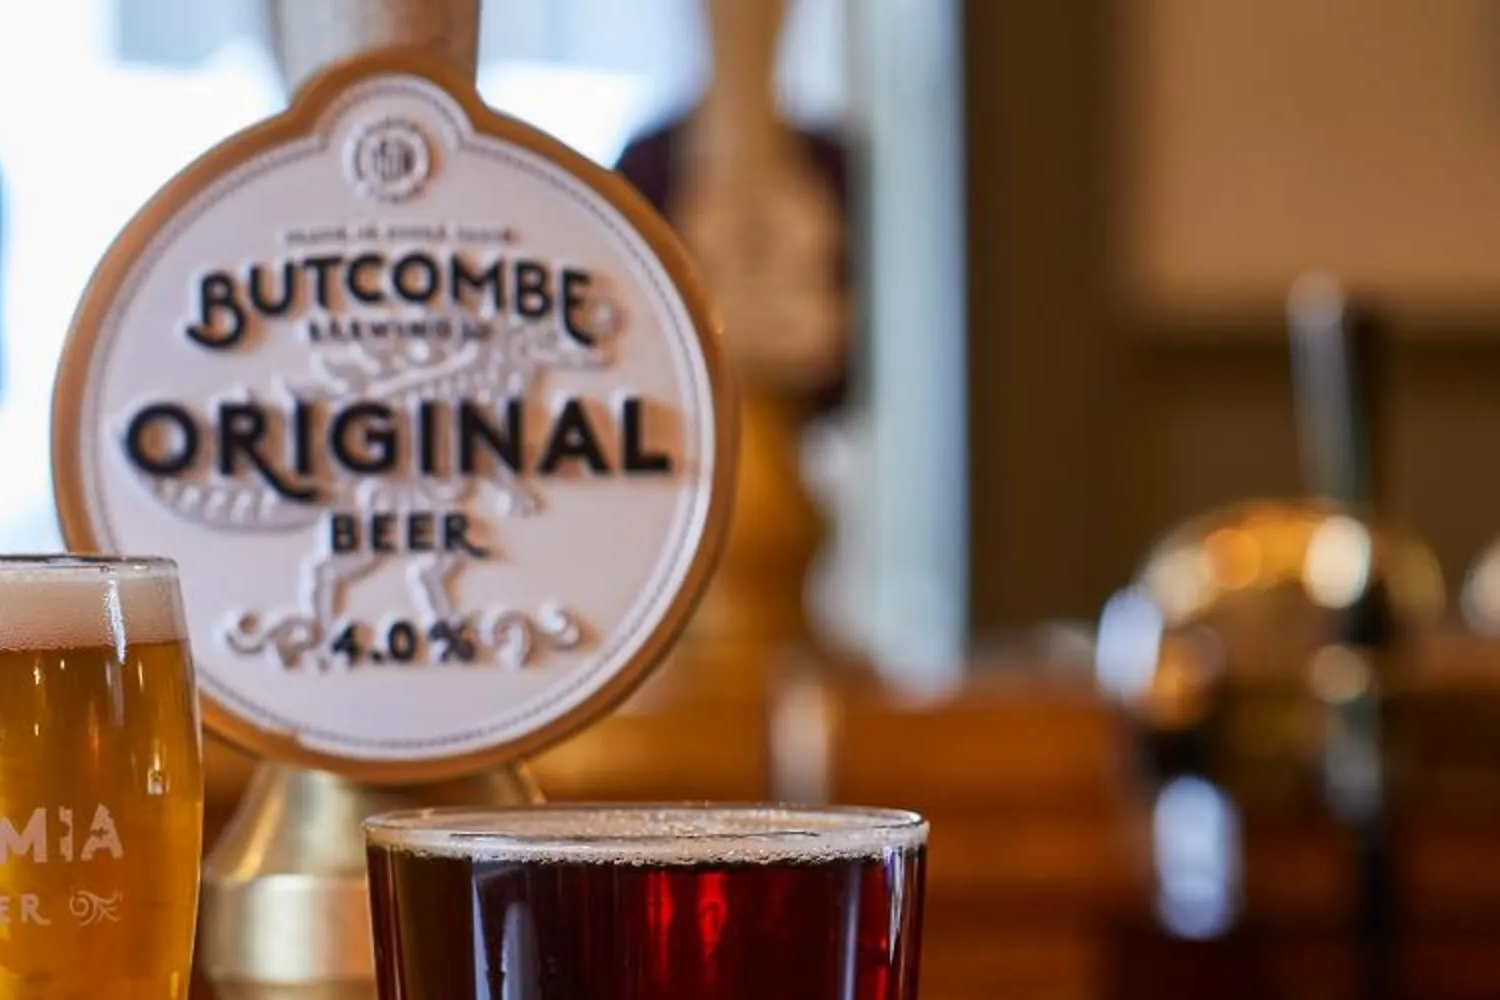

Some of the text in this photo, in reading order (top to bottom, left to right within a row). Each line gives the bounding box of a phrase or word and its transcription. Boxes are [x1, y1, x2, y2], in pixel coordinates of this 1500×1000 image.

[186, 252, 597, 349] BUTCOMBE
[124, 396, 671, 501] ORIGINAL
[330, 511, 490, 559] BEER
[332, 619, 477, 664] 4.0%
